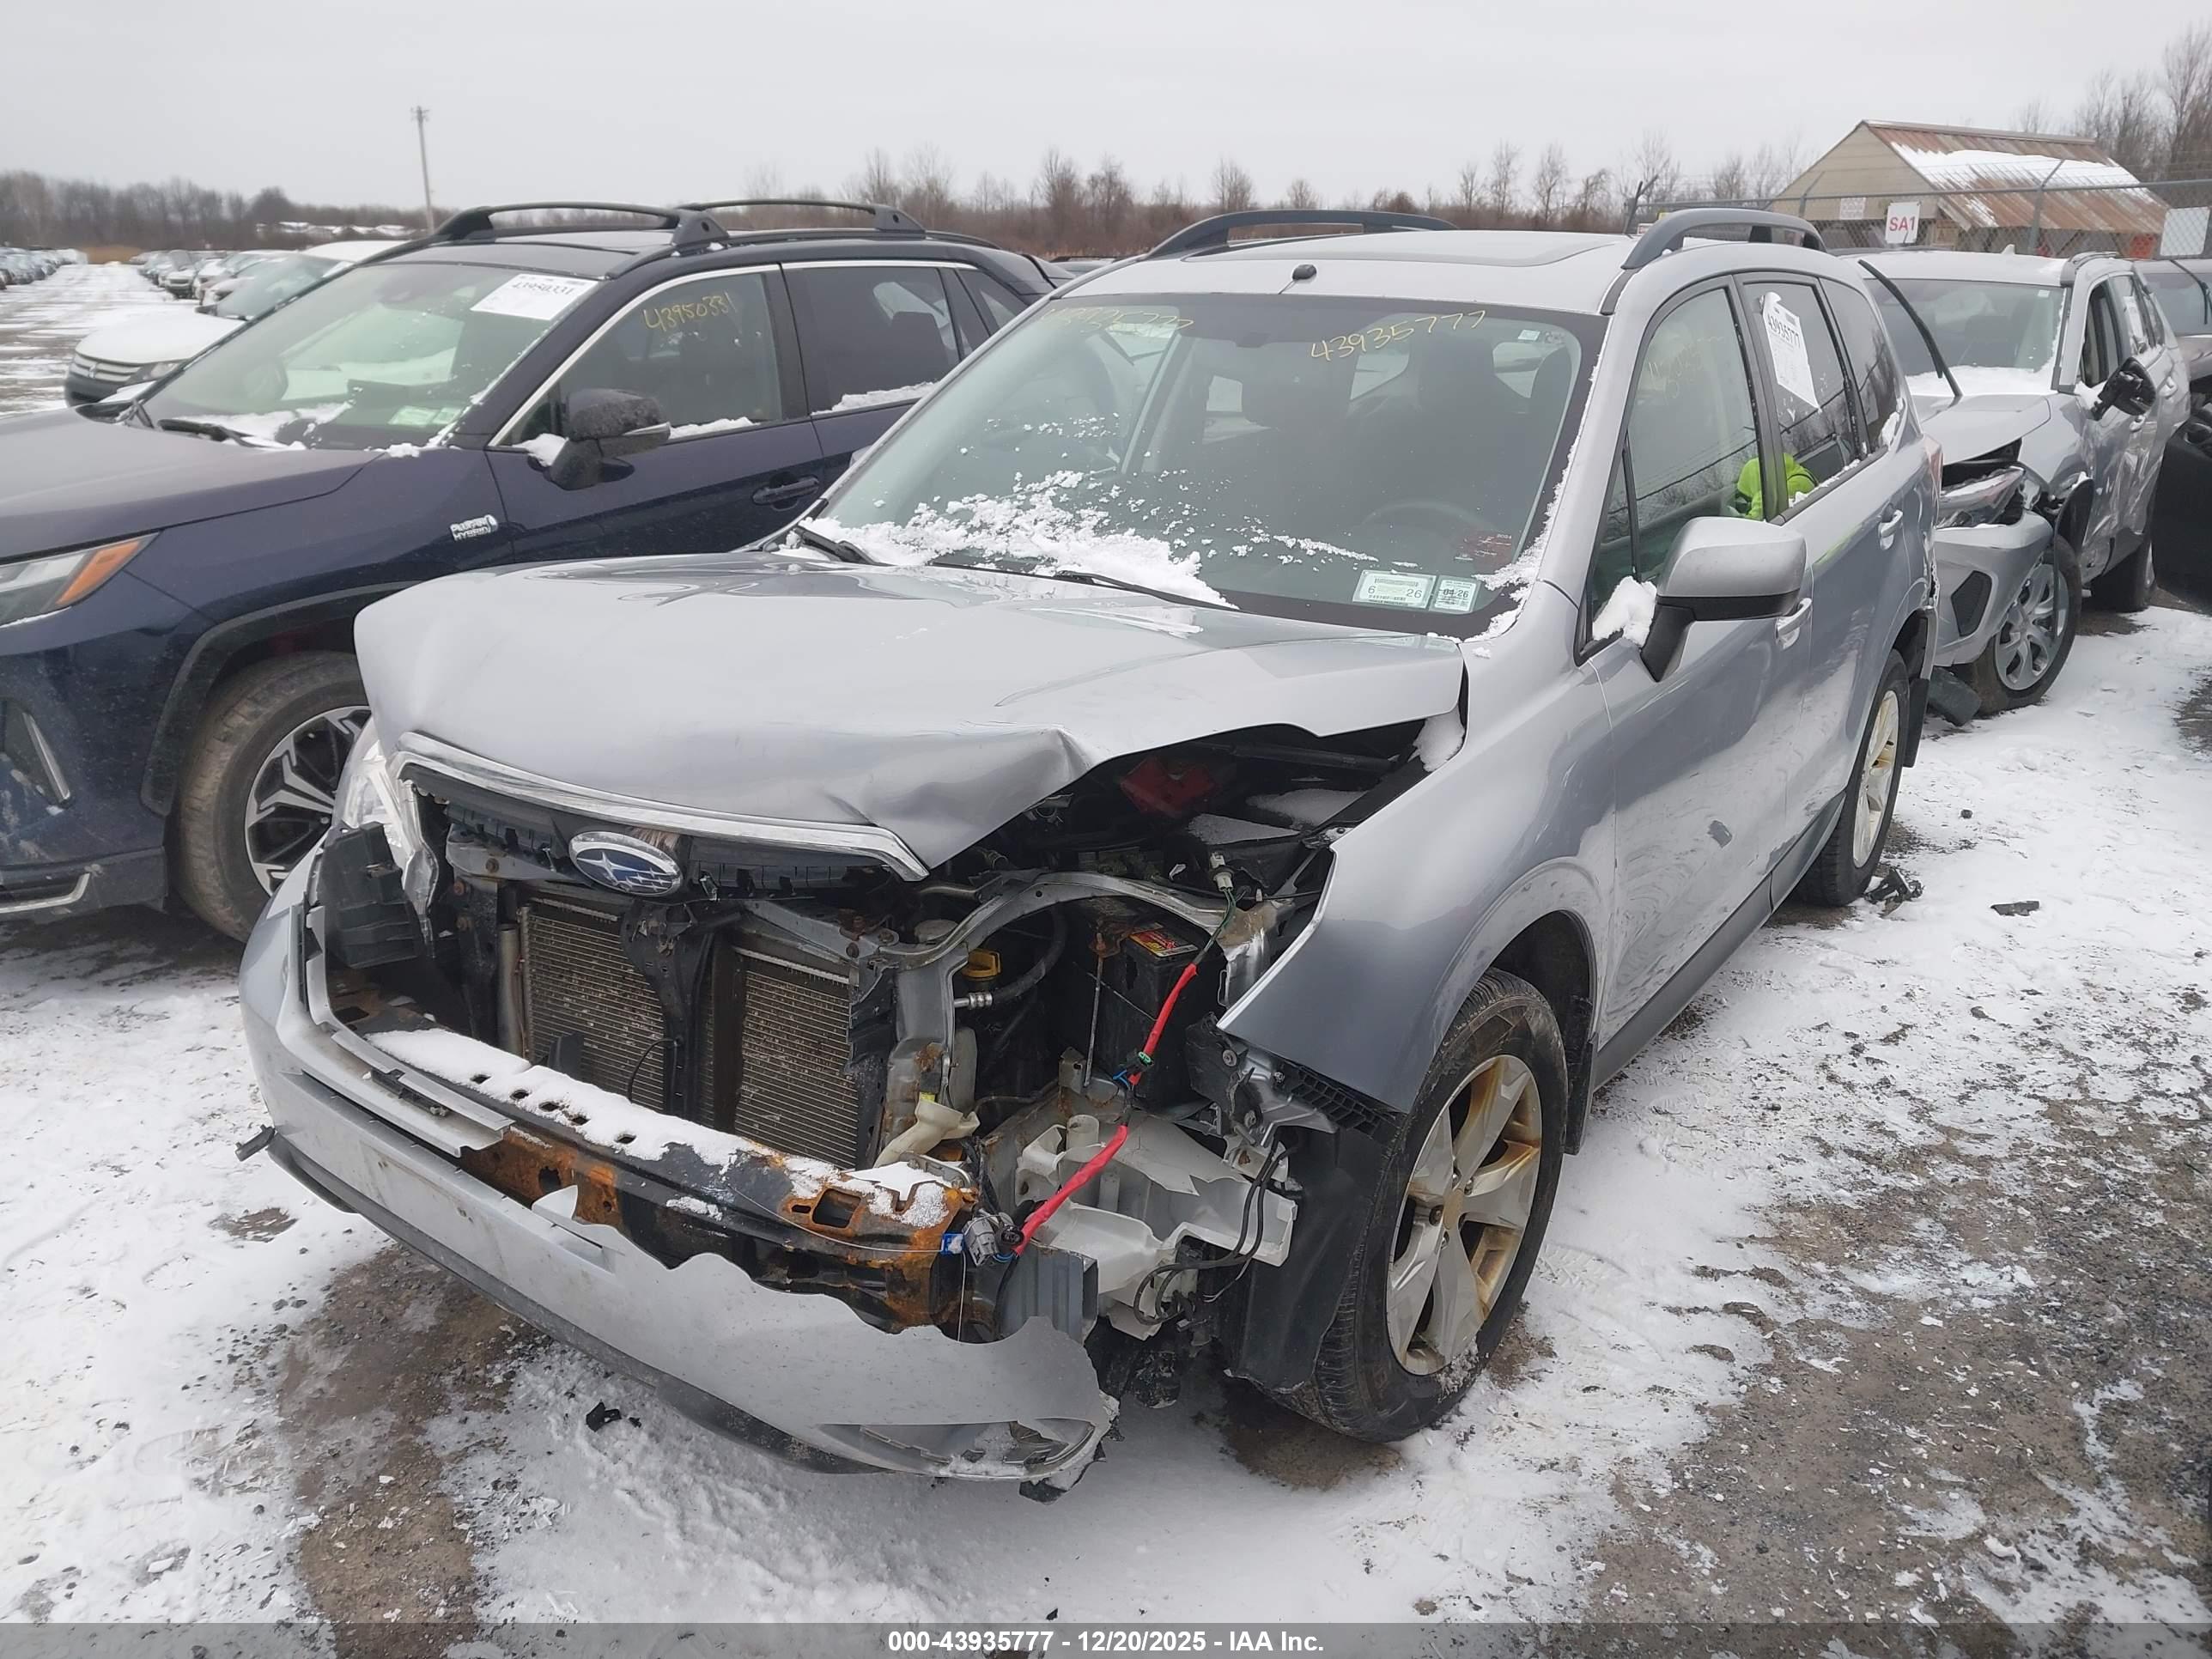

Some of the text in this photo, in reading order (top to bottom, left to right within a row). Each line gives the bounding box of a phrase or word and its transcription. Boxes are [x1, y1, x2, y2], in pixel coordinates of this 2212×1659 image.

[1889, 216, 1915, 231] SA1
[1310, 310, 1486, 361] 43935777
[1406, 588, 1423, 599] 26
